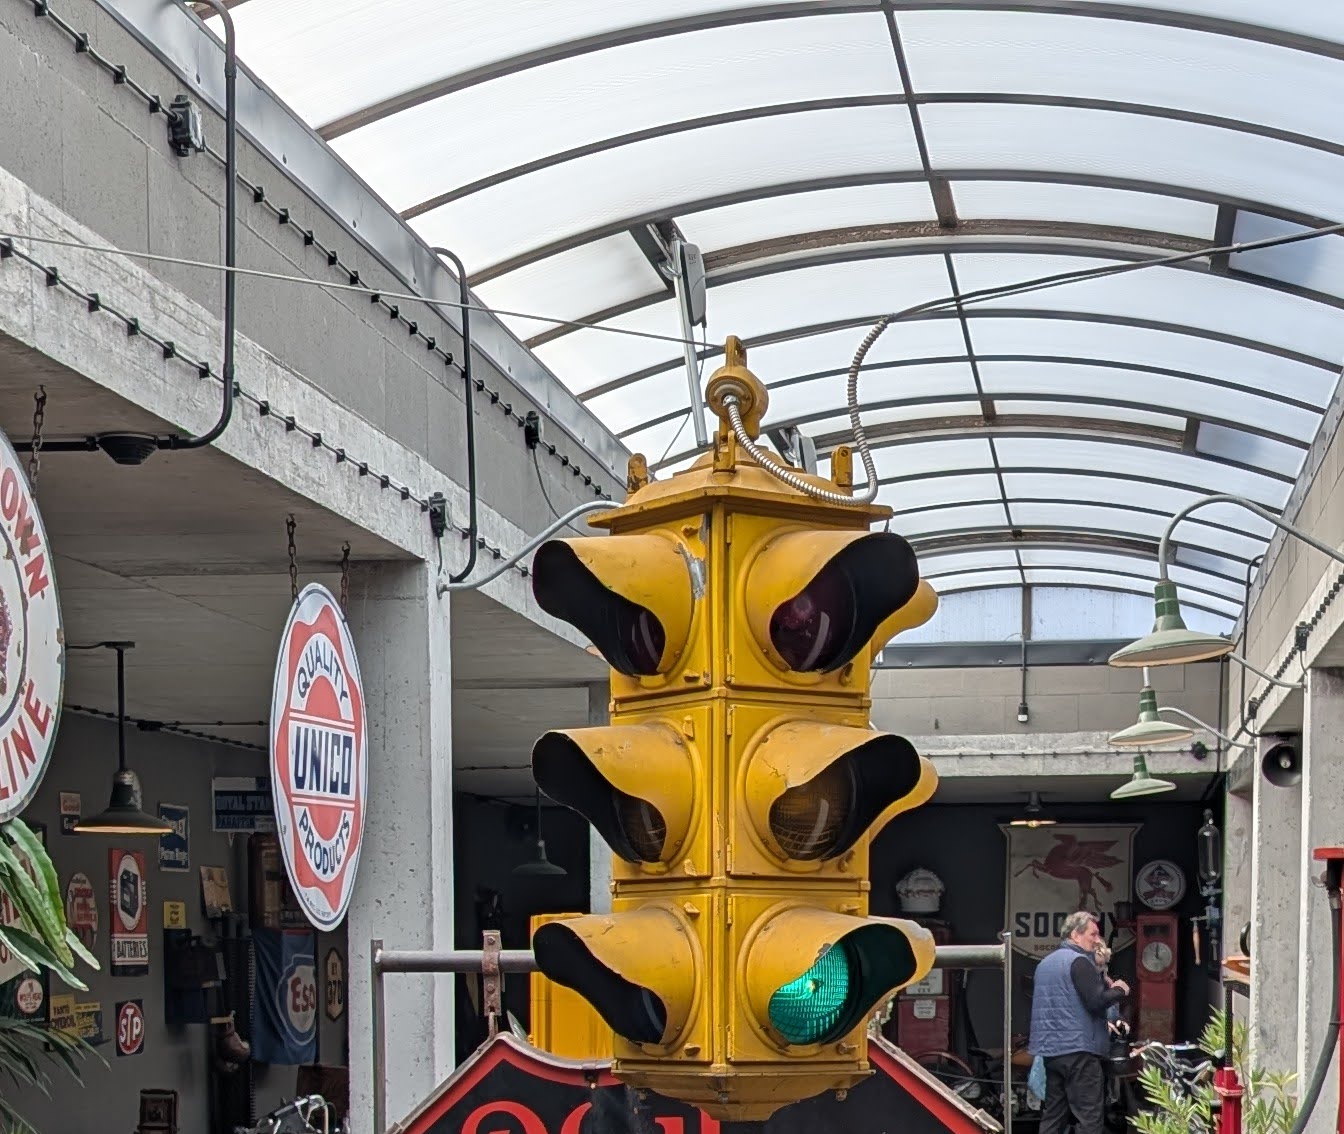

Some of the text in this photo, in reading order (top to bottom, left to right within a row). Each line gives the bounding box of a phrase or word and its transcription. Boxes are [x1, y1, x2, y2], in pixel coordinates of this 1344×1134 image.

[297, 641, 349, 699] QUALITY
[294, 726, 353, 796] UNICO
[299, 809, 351, 876] PRODUCTS
[120, 1007, 142, 1047] STP
